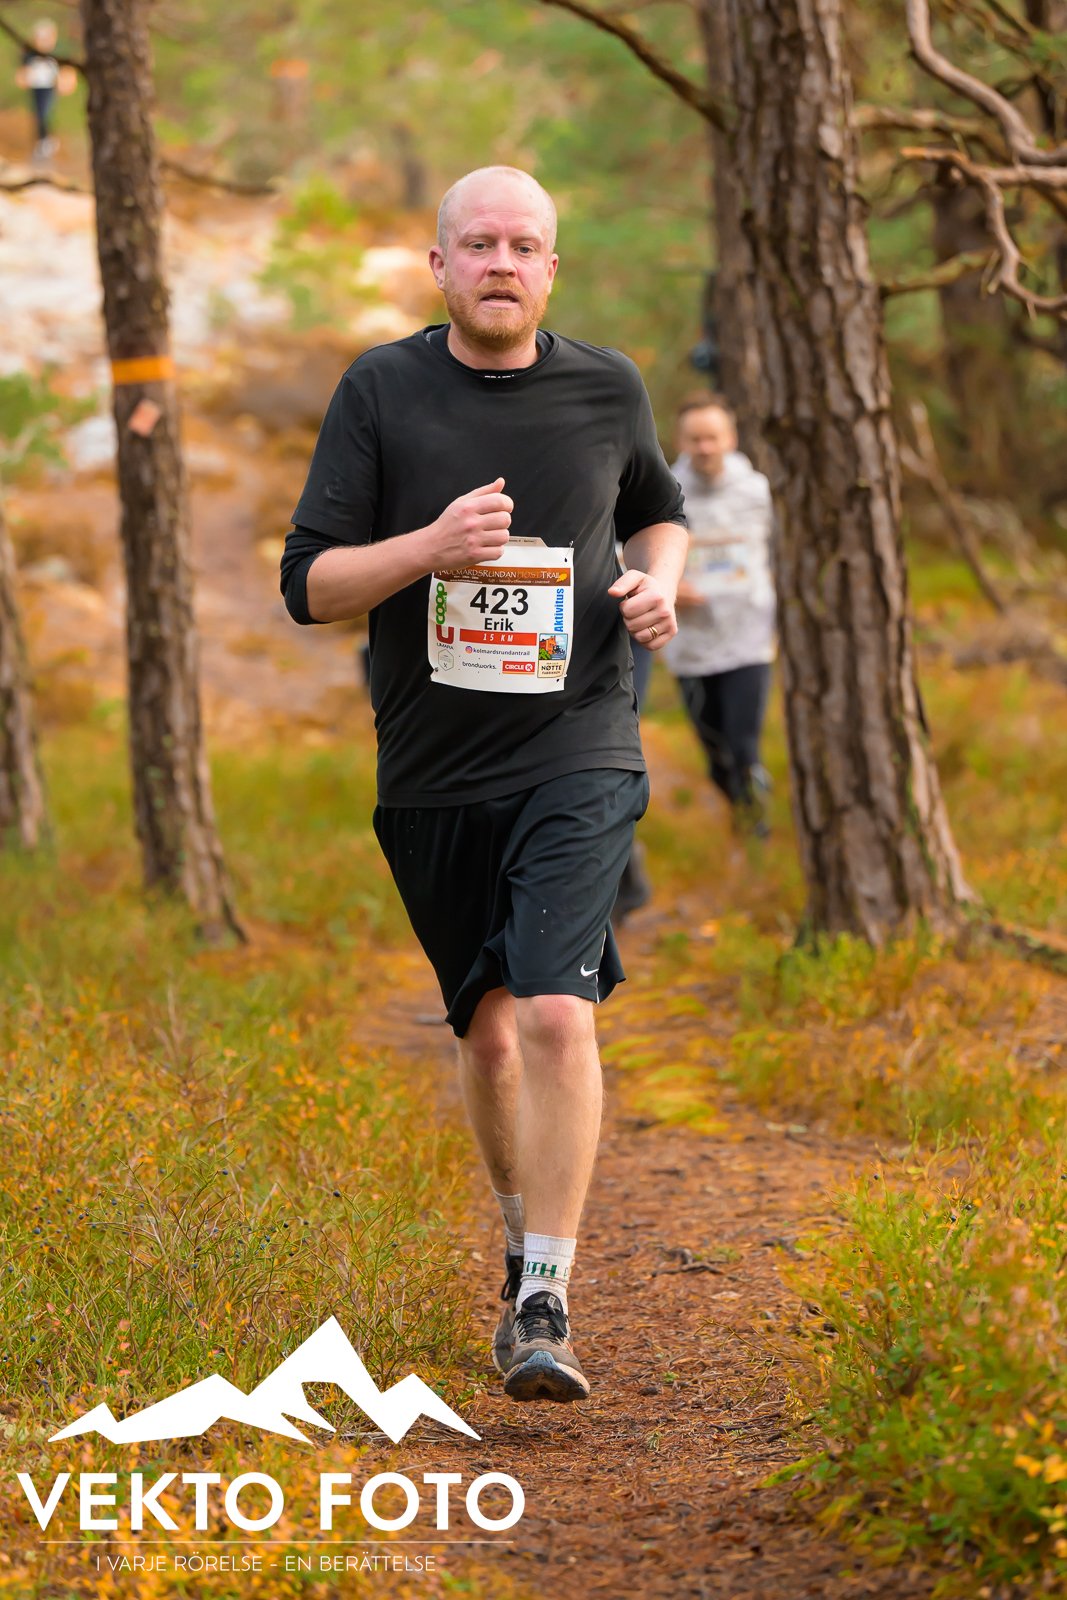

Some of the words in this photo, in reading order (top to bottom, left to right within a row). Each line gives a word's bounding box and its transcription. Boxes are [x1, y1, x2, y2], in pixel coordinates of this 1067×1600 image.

[436, 582, 447, 625] coop
[469, 586, 529, 616] 423
[554, 588, 564, 632] Aktivitus
[483, 633, 495, 642] 15
[500, 634, 514, 642] KM
[484, 617, 514, 632] Erik
